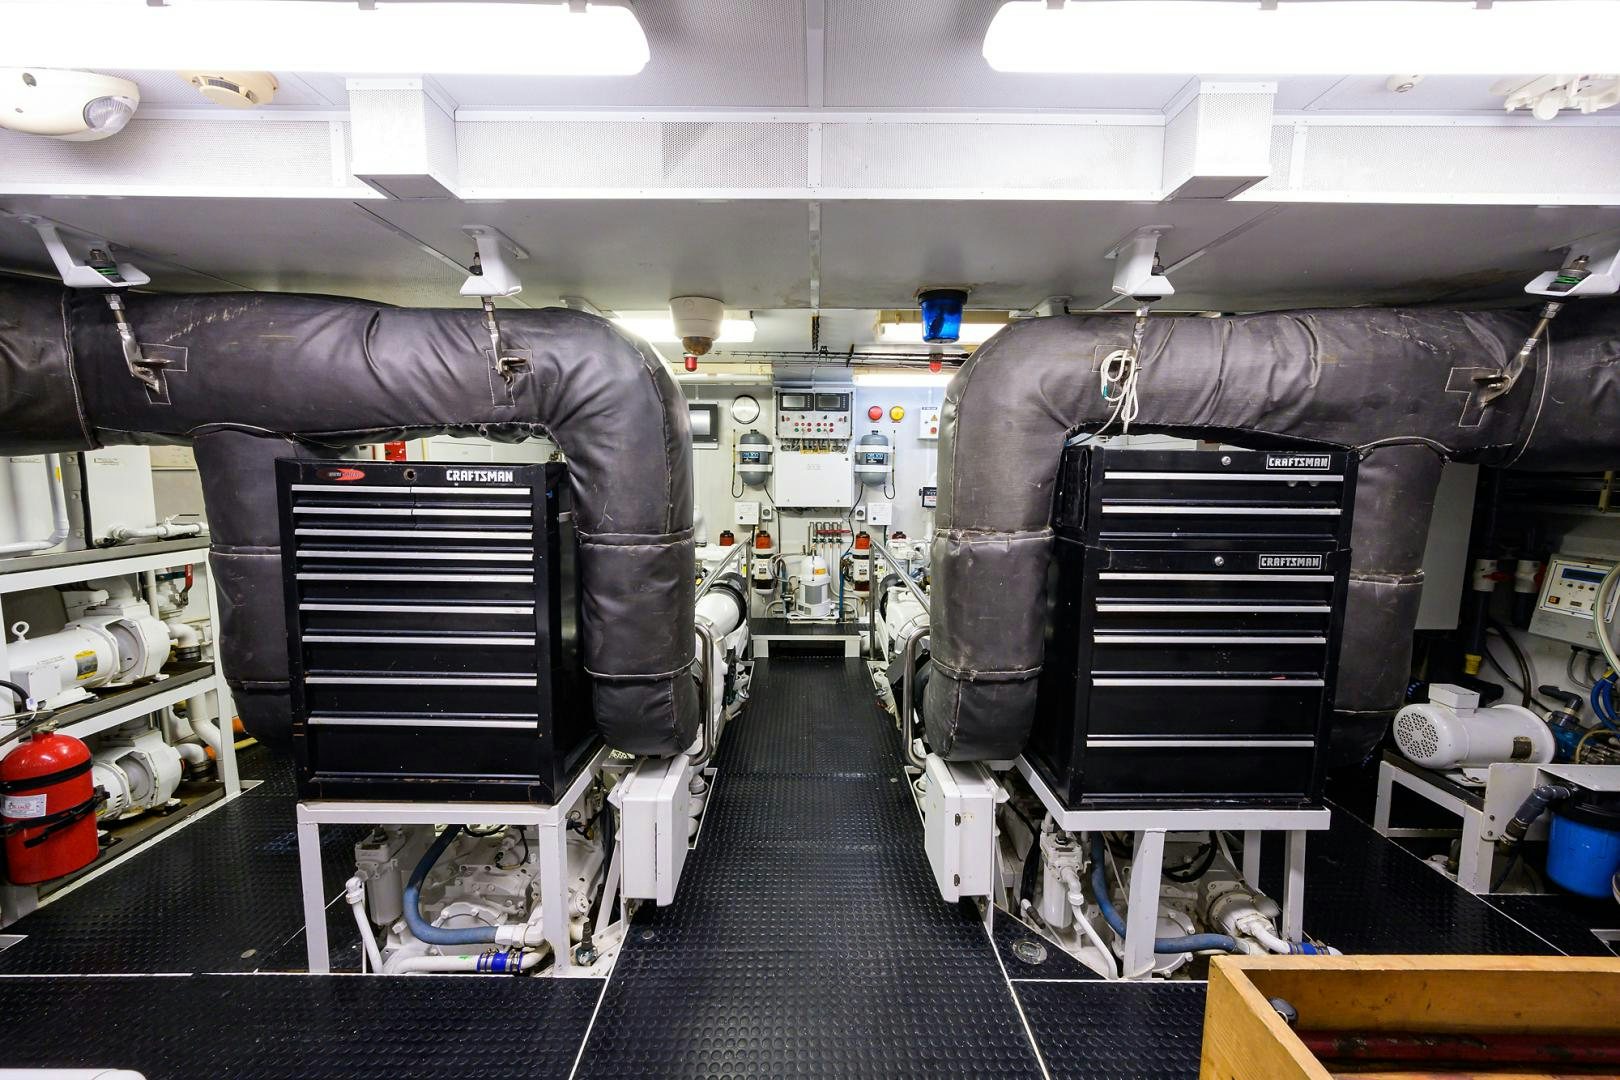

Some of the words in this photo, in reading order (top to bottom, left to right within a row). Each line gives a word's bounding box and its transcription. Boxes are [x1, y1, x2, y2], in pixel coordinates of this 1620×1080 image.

[1268, 457, 1328, 467] CRAFTSMAN
[446, 470, 513, 482] CRAFTSMAN
[1261, 557, 1320, 567] CRAFTSMAN
